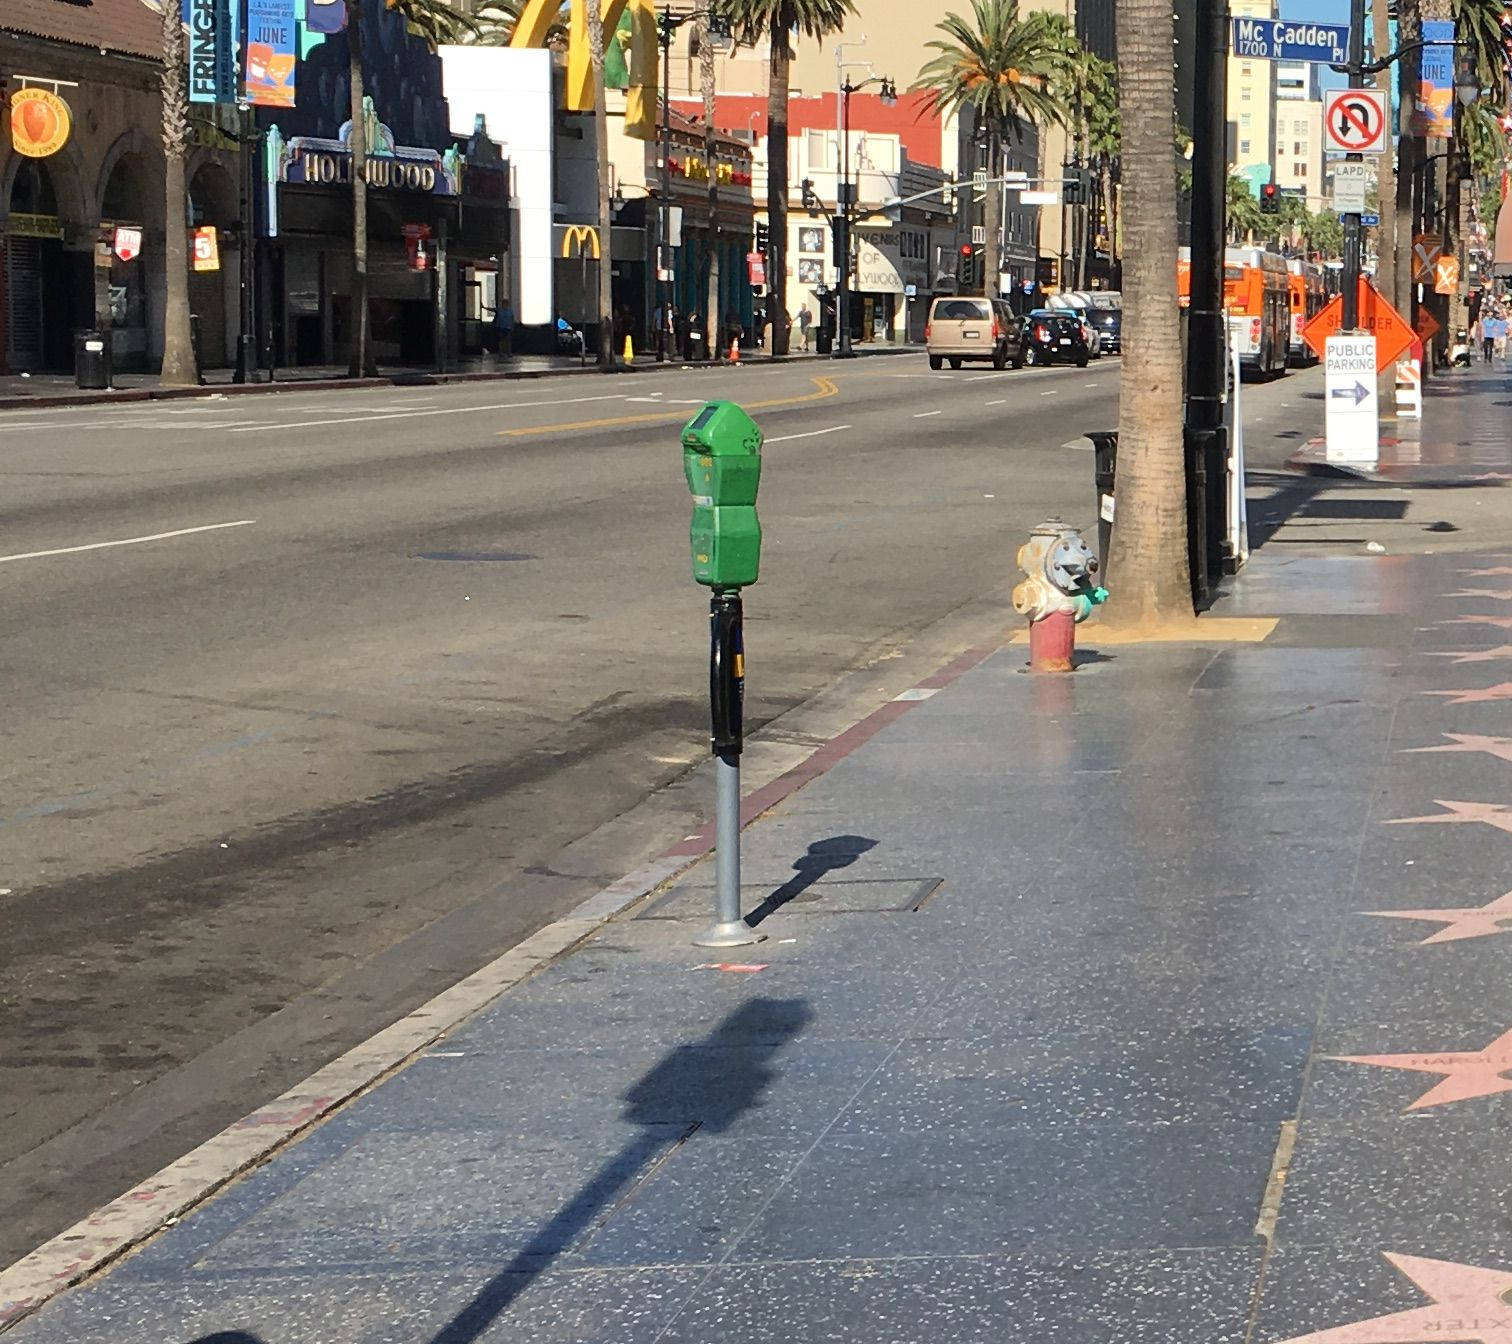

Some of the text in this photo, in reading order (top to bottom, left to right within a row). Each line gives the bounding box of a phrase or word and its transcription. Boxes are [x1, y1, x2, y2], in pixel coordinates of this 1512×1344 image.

[254, 26, 288, 45] JUNE
[1238, 20, 1338, 48] Mc Cadden
[1238, 41, 1282, 58] 1700 N
[1332, 47, 1344, 62] Pl
[1423, 64, 1446, 80] UNE
[304, 152, 436, 192] HOLWOOD
[1335, 165, 1364, 176] LAPD
[117, 229, 142, 243] ATM
[195, 236, 212, 259] 5
[1327, 314, 1393, 330] SHLDER
[1326, 343, 1375, 357] PUBLIC
[1326, 358, 1375, 371] PARKING
